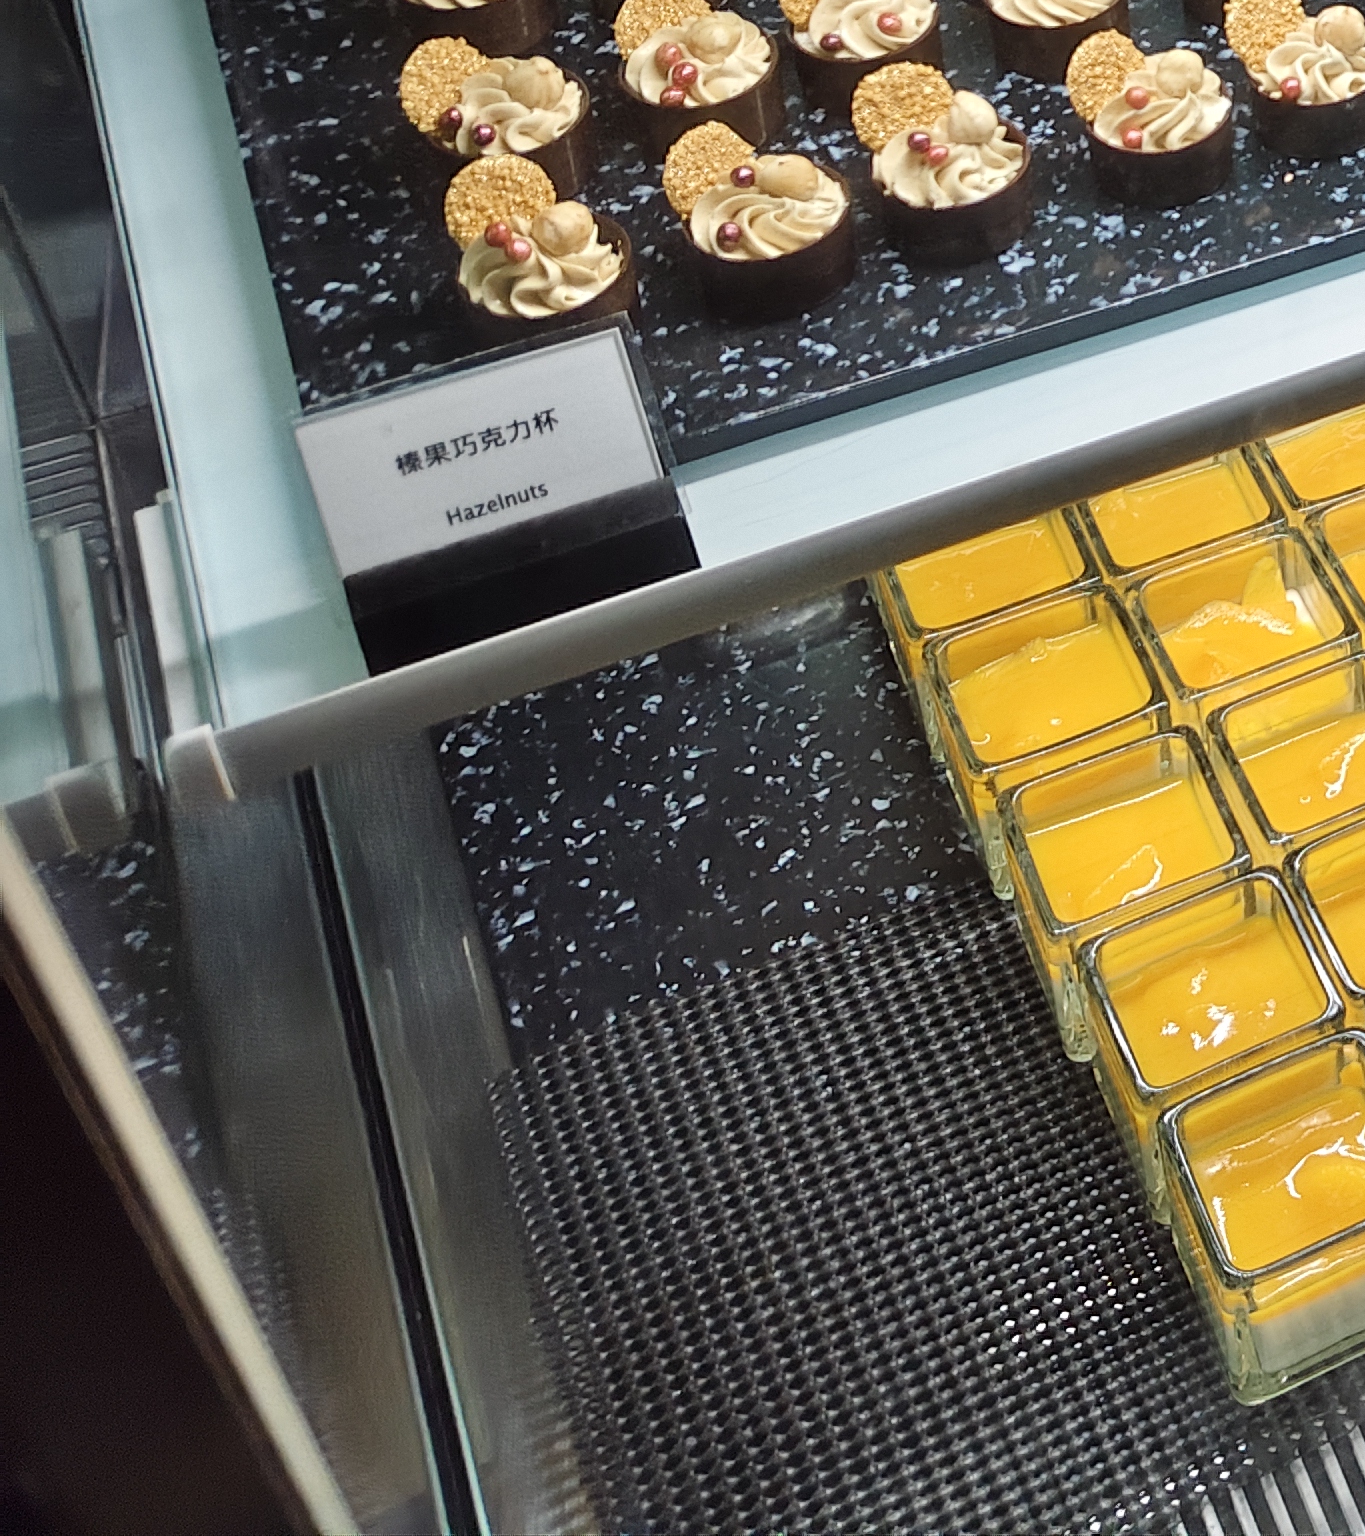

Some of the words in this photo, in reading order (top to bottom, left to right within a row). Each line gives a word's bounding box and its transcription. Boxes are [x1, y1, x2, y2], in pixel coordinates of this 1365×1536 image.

[394, 407, 559, 477] 榛果巧克力杯
[445, 480, 549, 527] Hazelnuts
